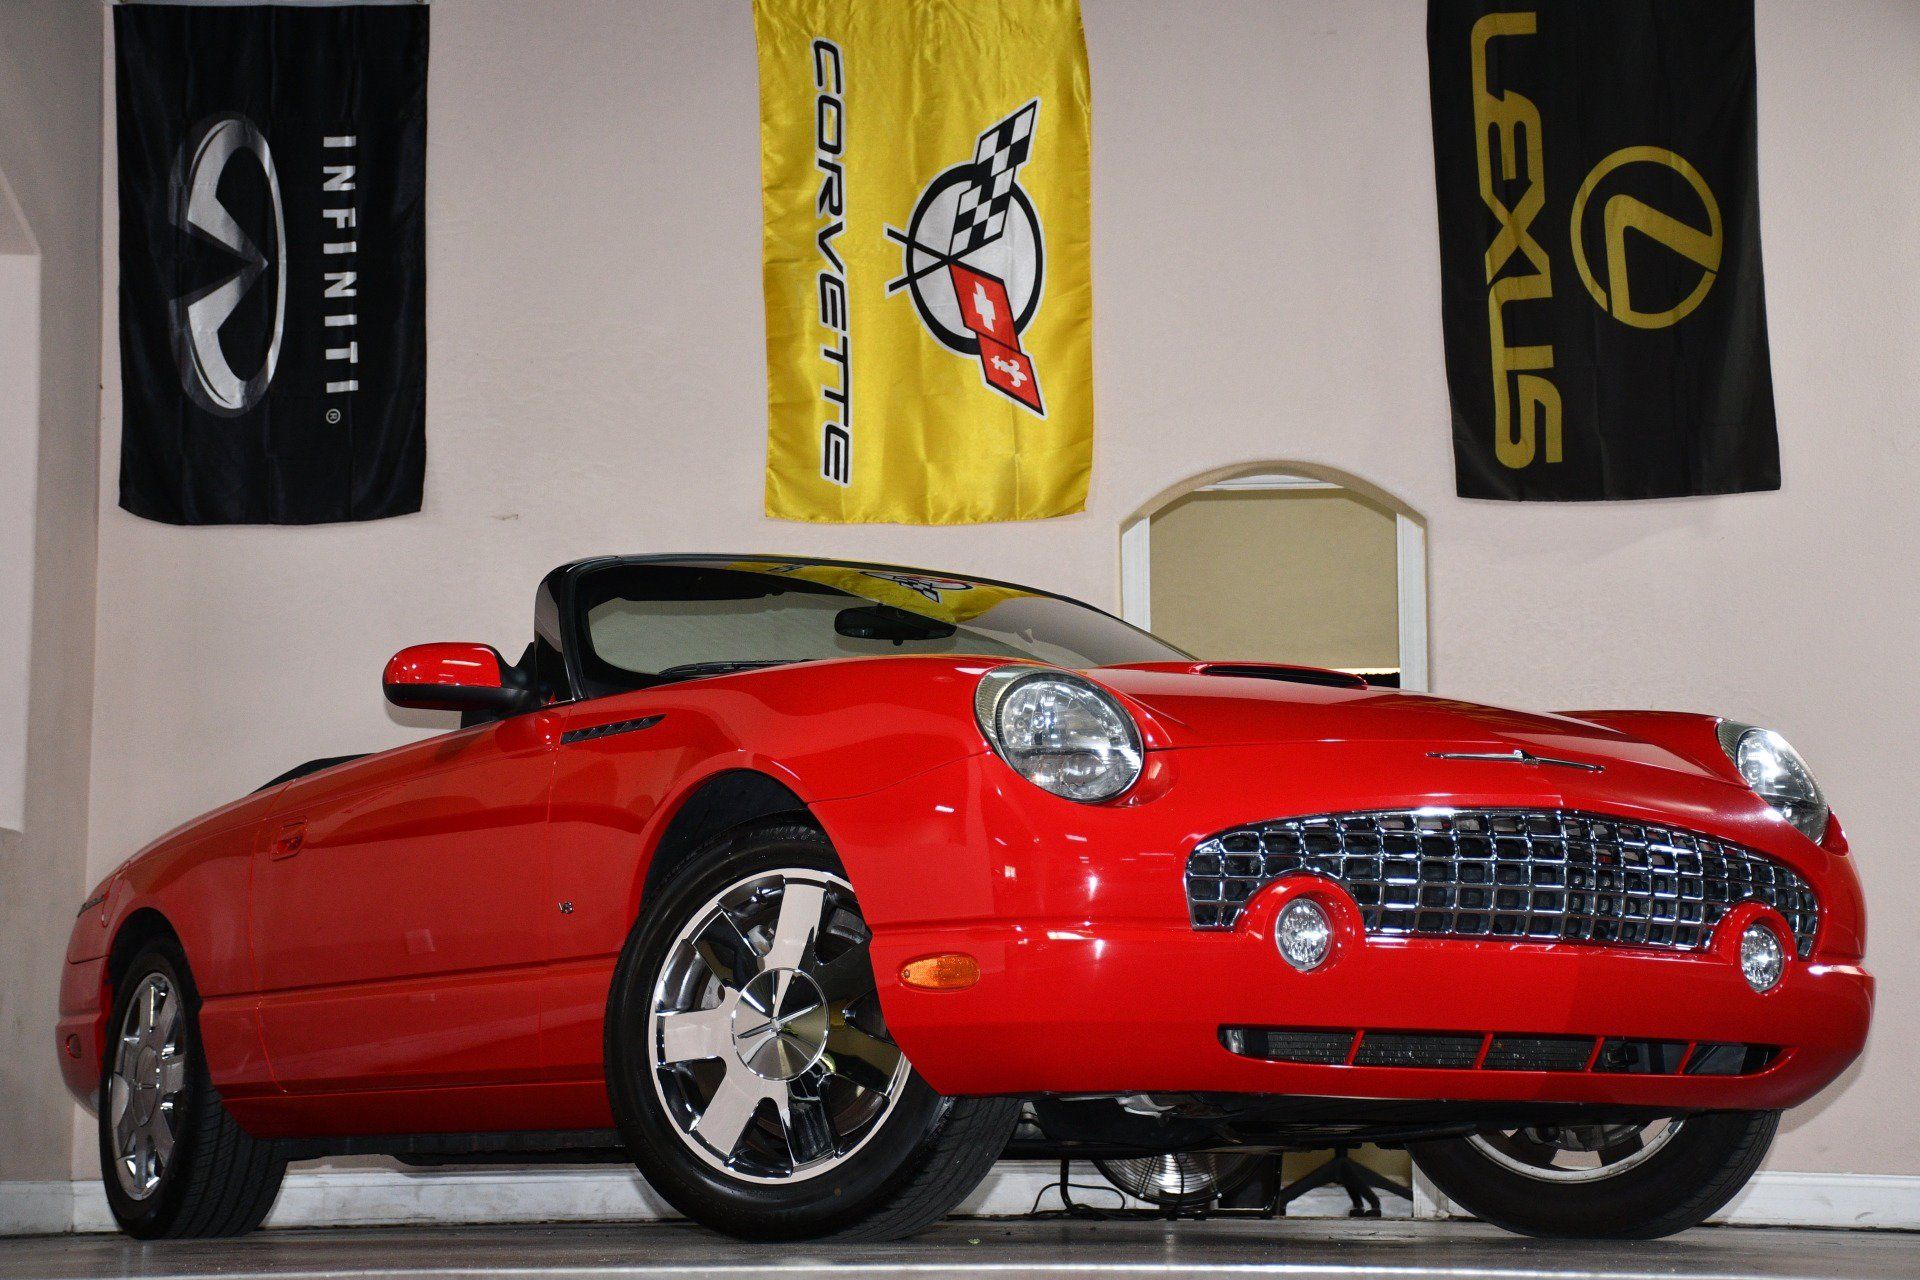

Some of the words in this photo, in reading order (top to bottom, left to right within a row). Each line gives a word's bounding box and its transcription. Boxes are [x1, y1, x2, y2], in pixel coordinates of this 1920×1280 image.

[323, 135, 359, 394] INFINITI
[813, 39, 849, 484] CORVETTE
[1470, 12, 1563, 470] LEXUS
